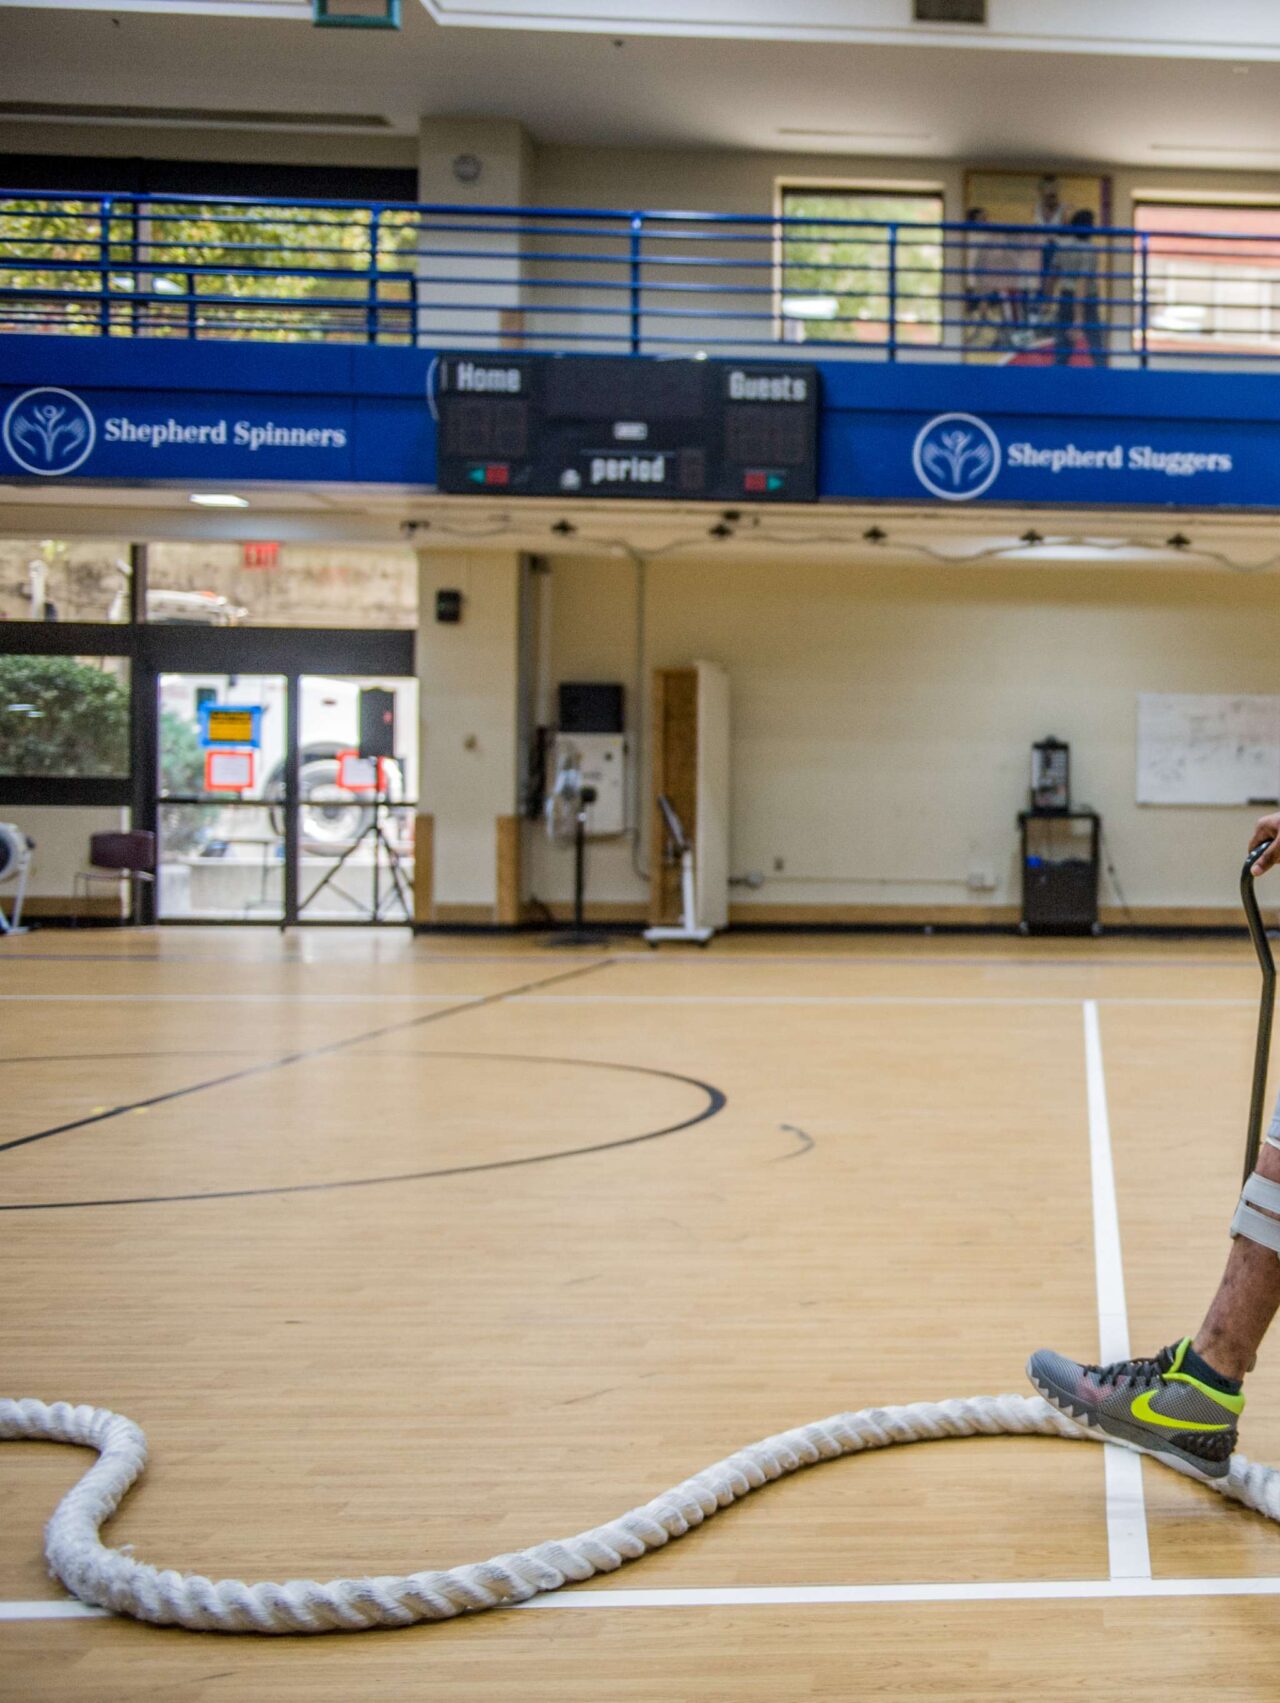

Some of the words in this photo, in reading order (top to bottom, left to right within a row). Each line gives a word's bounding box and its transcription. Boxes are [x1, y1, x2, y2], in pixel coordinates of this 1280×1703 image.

[456, 362, 522, 393] Home
[729, 371, 807, 401] Guests
[104, 418, 227, 448] Shepherd
[233, 421, 347, 451] Spinners
[591, 455, 665, 485] period
[1007, 443, 1124, 474] Shepherd
[1127, 446, 1234, 476] Sluggers
